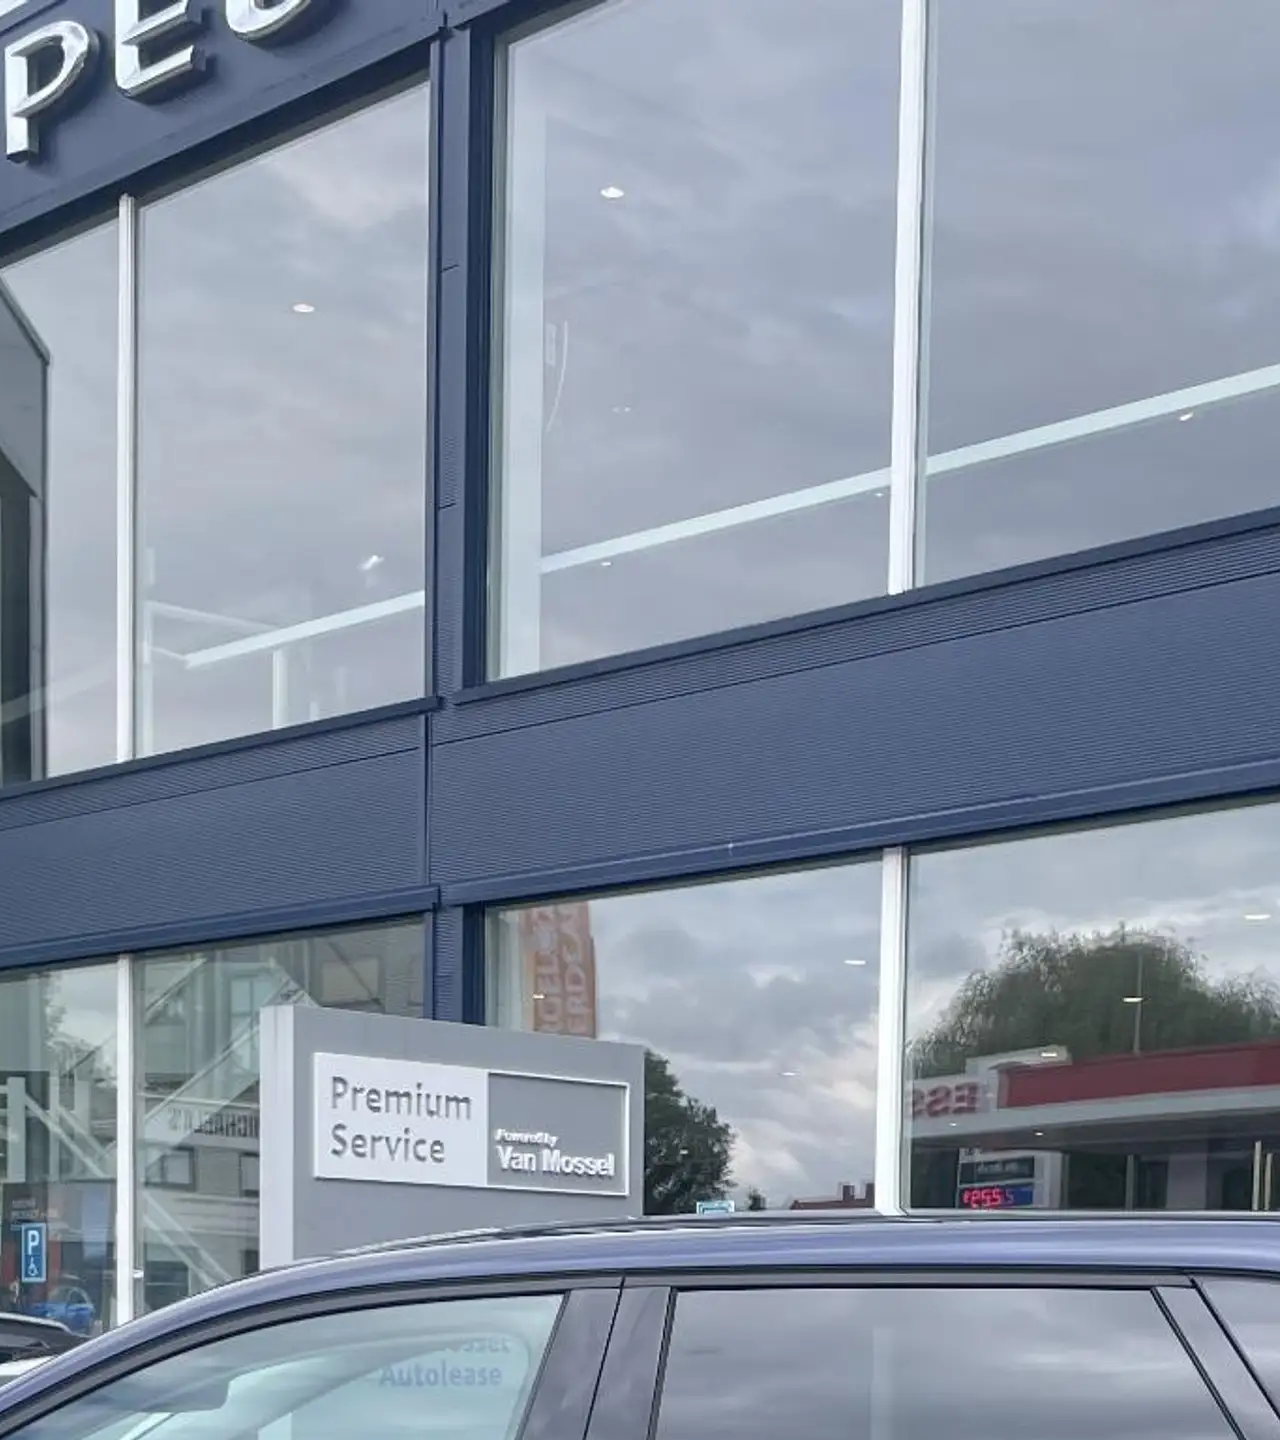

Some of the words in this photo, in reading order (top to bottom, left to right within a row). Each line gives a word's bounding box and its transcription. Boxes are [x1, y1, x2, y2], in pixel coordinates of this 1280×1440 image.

[330, 1075, 472, 1120] Premium
[330, 1122, 445, 1164] Service
[496, 1145, 537, 1172] Van
[541, 1148, 615, 1177] Mossel
[27, 1229, 40, 1256] P
[380, 1360, 503, 1388] Autolease
